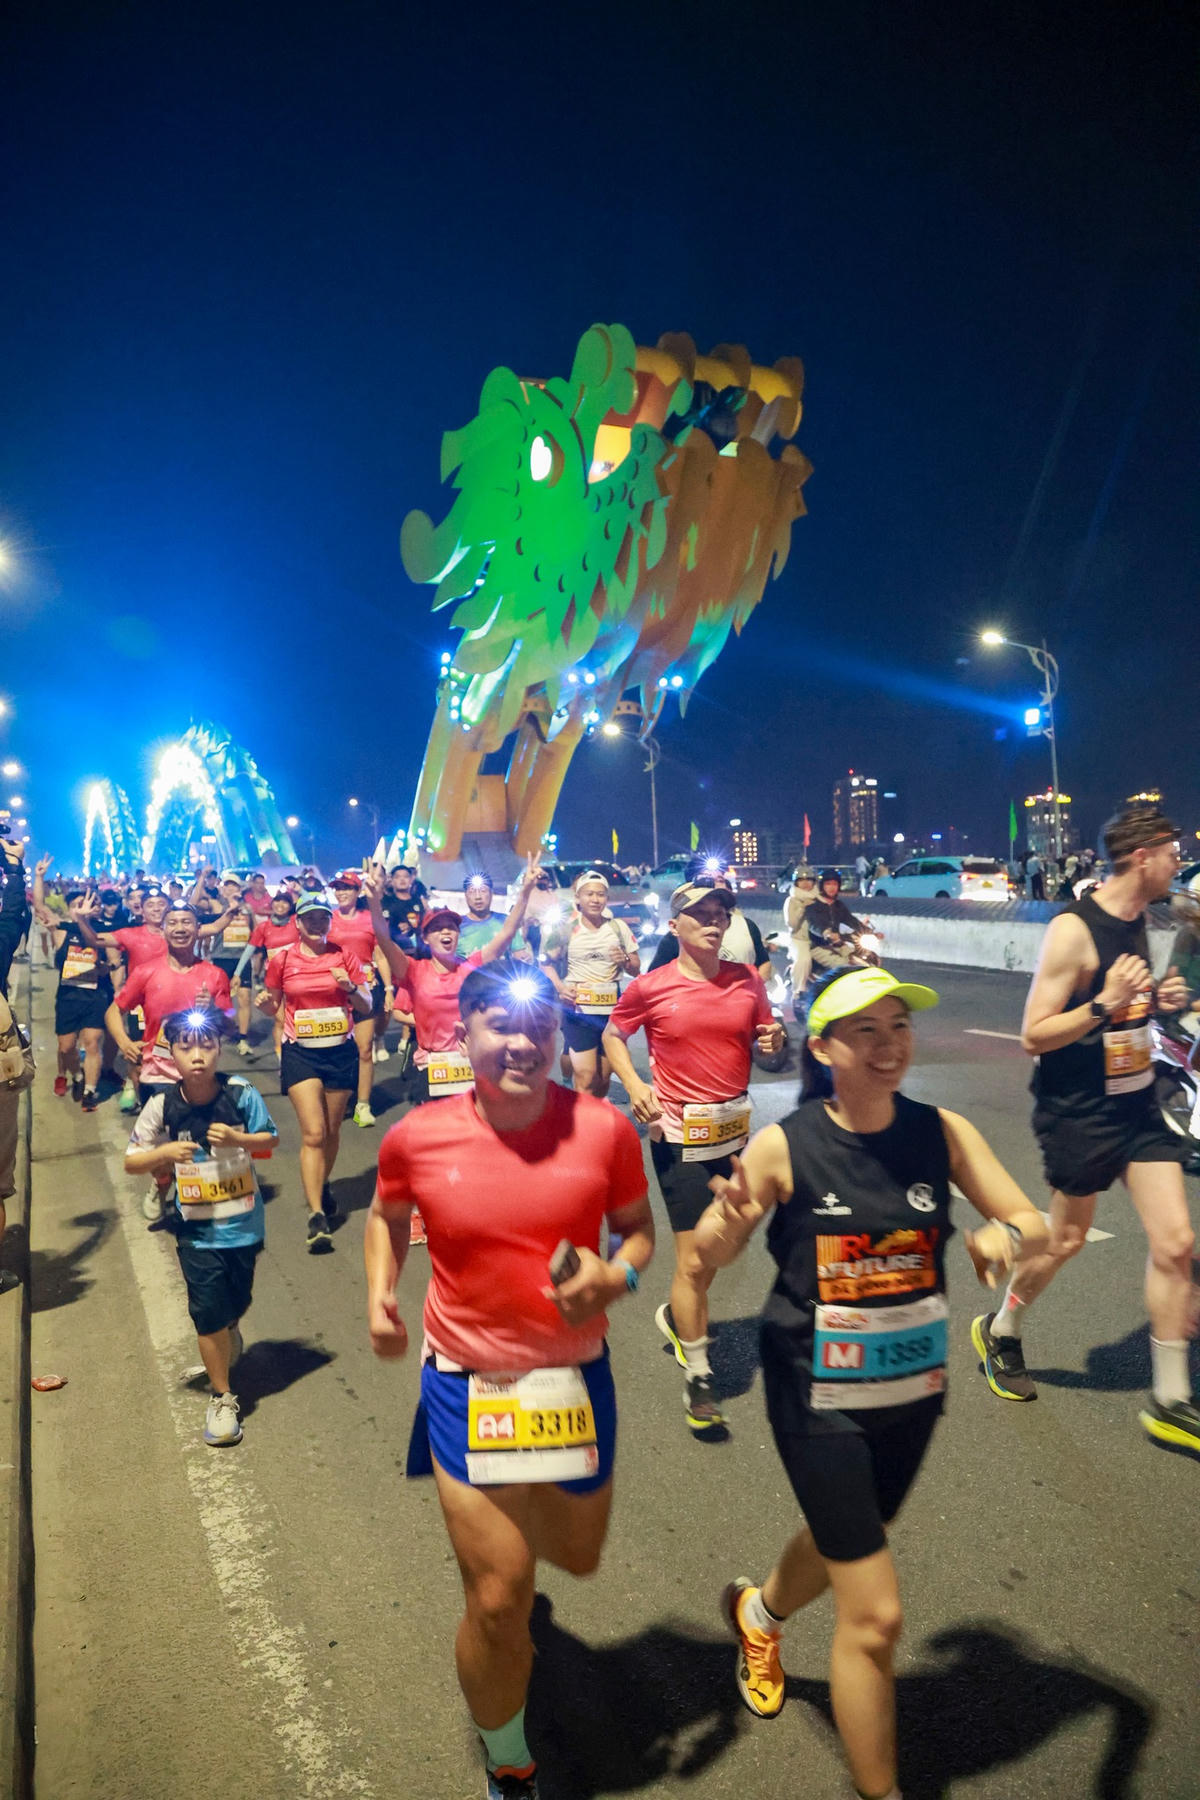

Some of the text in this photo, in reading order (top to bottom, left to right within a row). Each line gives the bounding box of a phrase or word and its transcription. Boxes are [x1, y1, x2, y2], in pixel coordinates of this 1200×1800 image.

[298, 1022, 343, 1034] B6 3553
[433, 1067, 473, 1079] A1 312
[689, 1127, 709, 1140] B6
[182, 1178, 244, 1198] B6 3561
[829, 1254, 926, 1279] FUTURE
[828, 1342, 860, 1369] M
[477, 1407, 587, 1440] A4 3318
